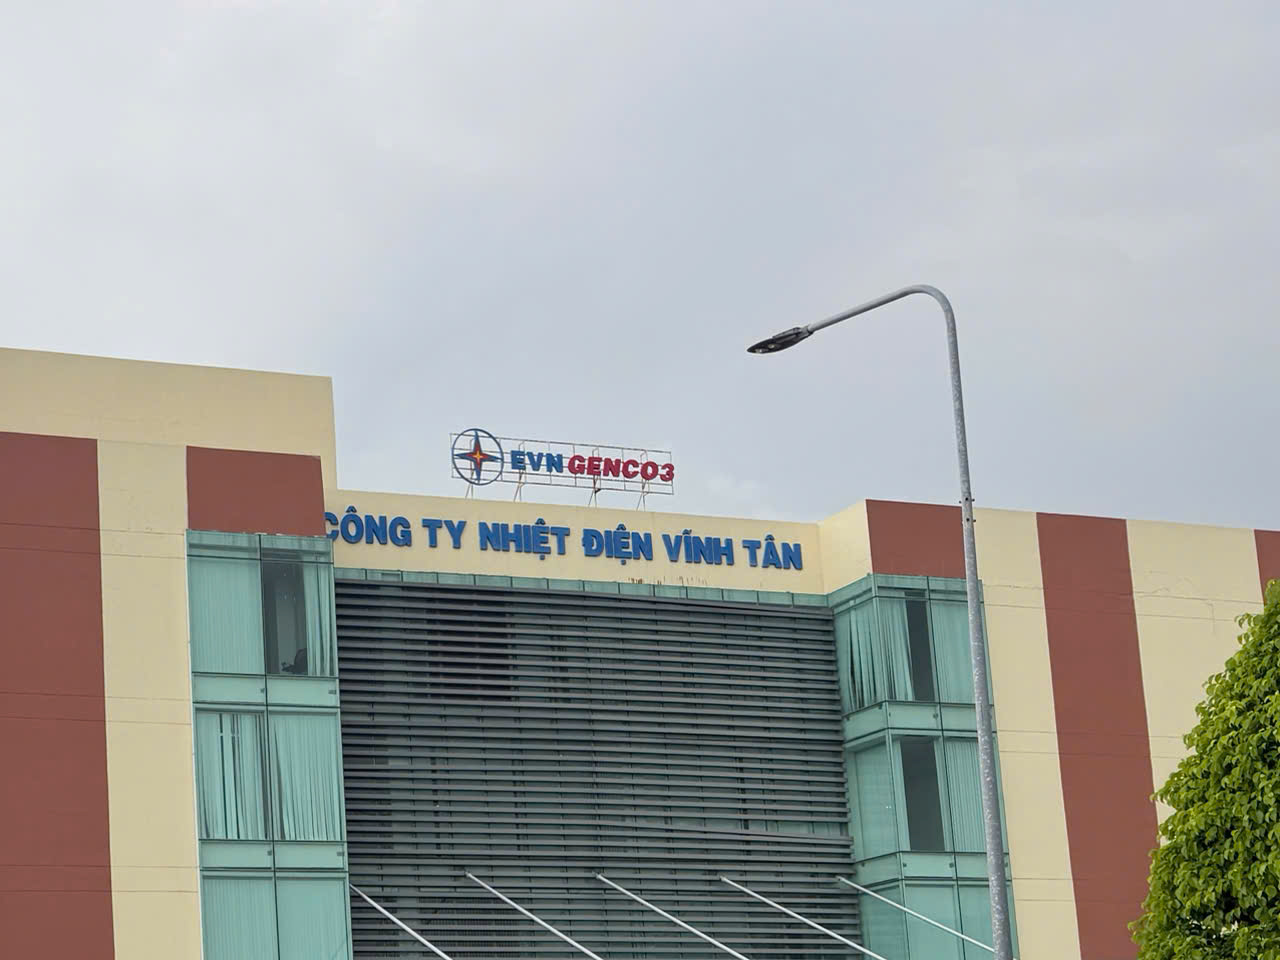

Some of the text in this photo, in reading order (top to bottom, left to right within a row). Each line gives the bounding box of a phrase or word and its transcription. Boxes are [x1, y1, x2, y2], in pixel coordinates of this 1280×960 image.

[511, 449, 675, 482] EVN GENCO3
[324, 505, 412, 547] CÔNG
[422, 518, 467, 549] TY
[478, 517, 570, 560] NHIỆT
[582, 523, 653, 565] ĐIỆN
[742, 534, 803, 571] TÂN
